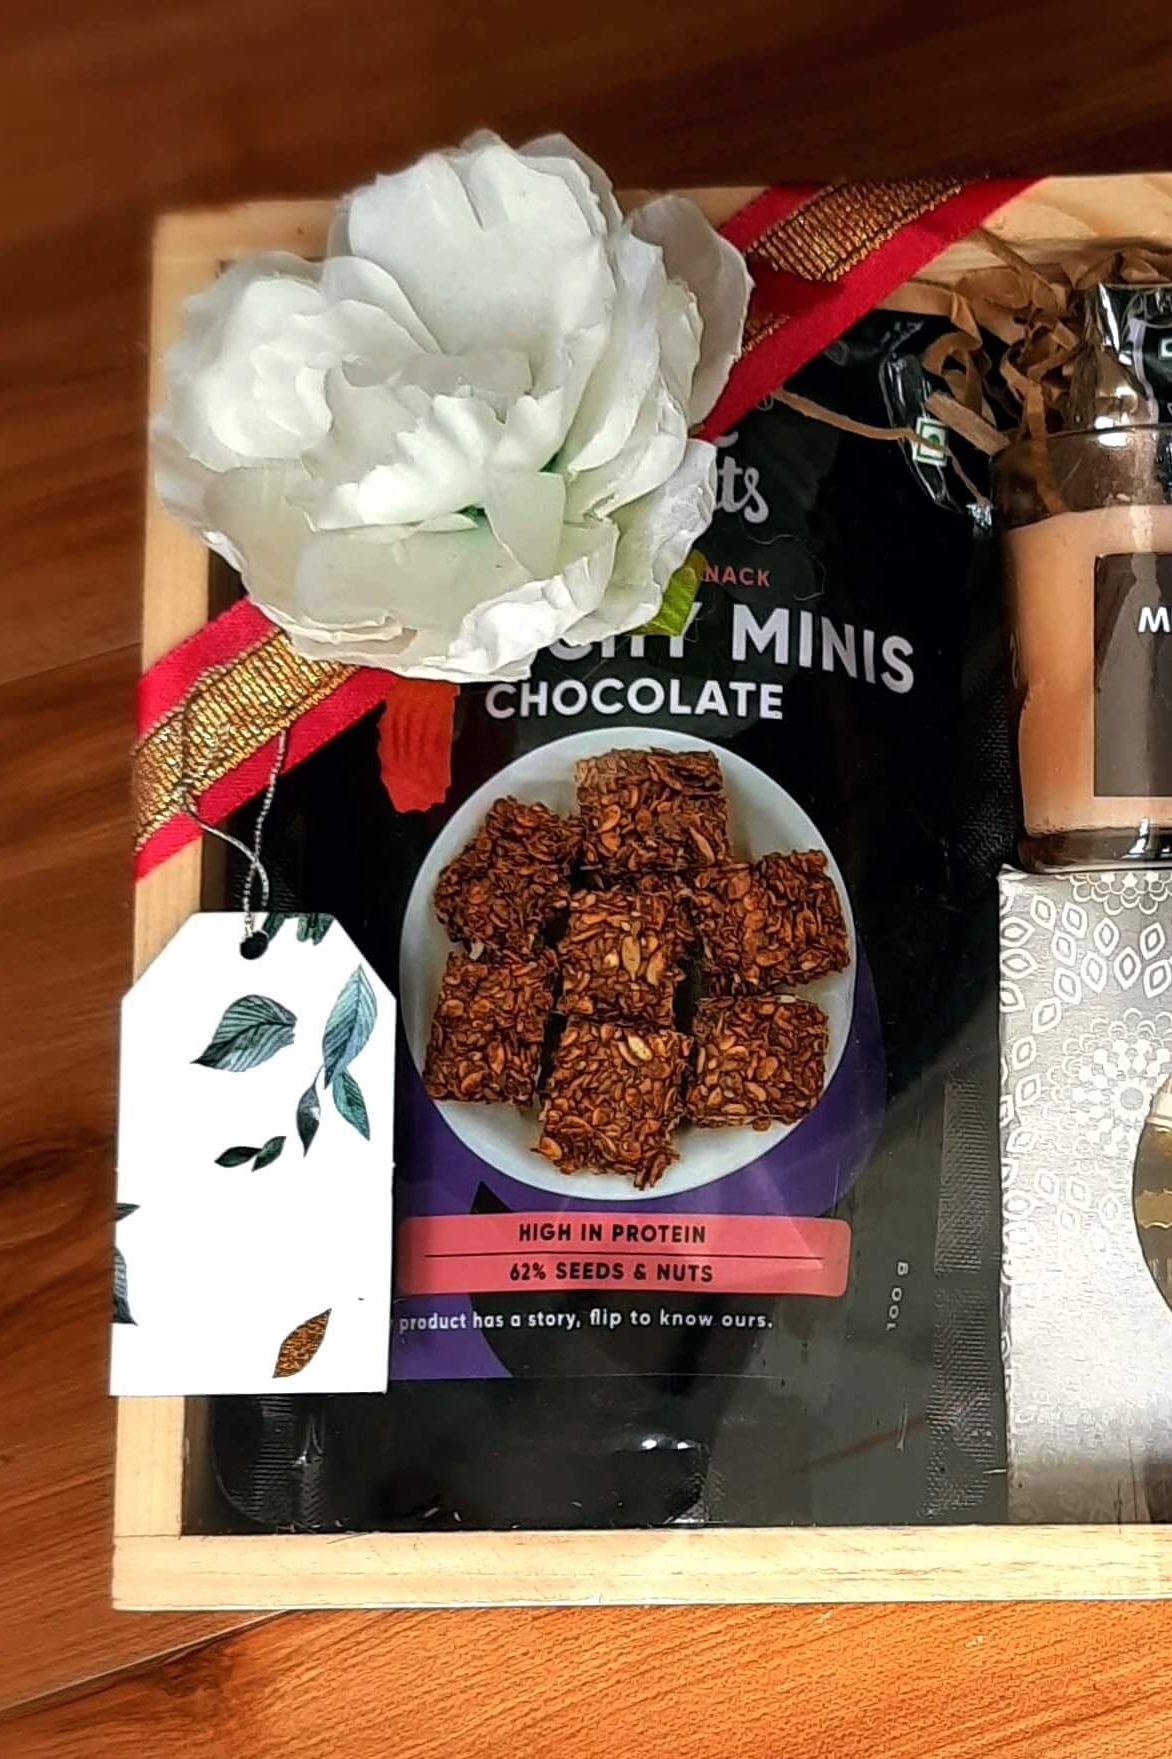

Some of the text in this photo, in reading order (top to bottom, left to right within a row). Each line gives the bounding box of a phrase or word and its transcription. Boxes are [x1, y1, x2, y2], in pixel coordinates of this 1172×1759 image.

[701, 565, 771, 588] NACK
[731, 603, 914, 694] MINIS
[485, 677, 784, 720] CHOCOLATE
[519, 1224, 707, 1244] HIGH IN PROTEIN
[509, 1262, 714, 1283] 62% SEEDS & NUTS
[400, 1309, 774, 1336] product has a story, flip to know ours.
[885, 1287, 903, 1332] 100
